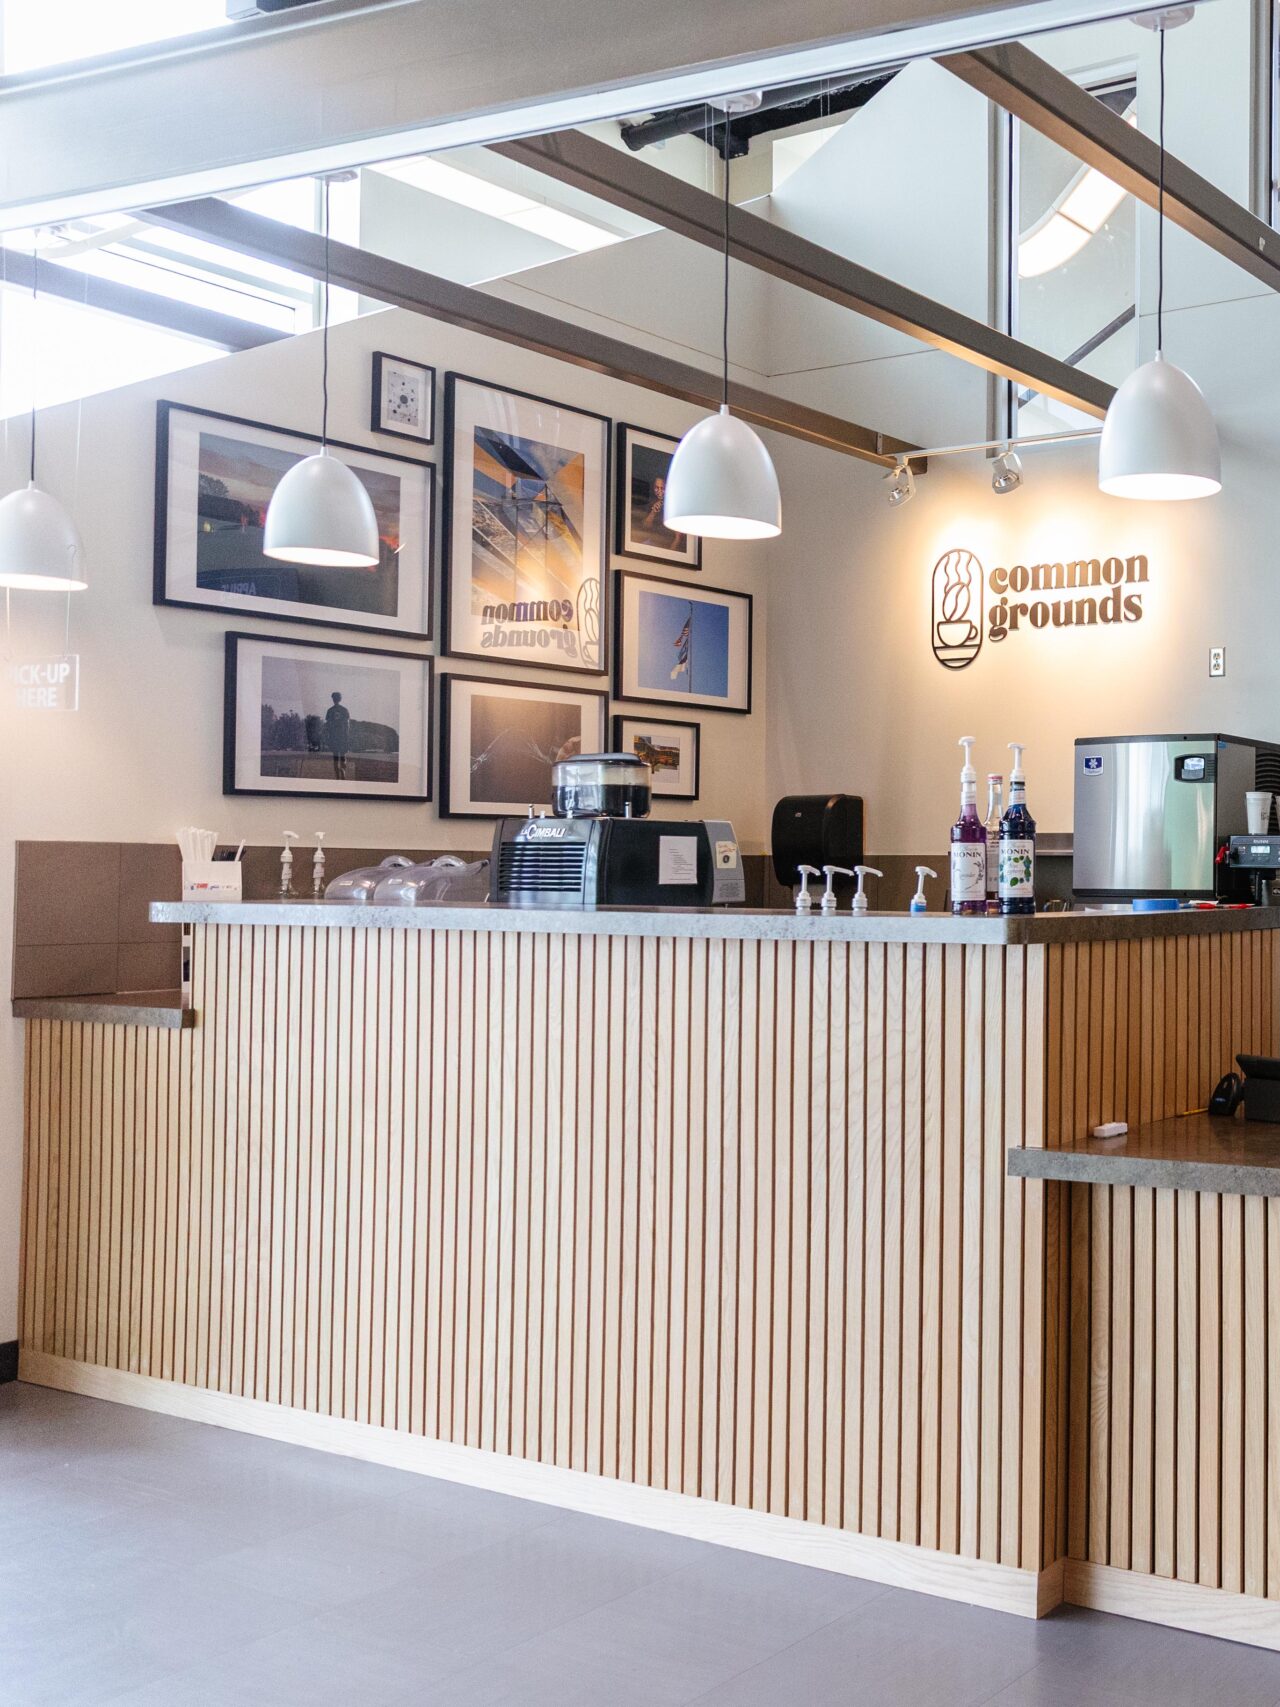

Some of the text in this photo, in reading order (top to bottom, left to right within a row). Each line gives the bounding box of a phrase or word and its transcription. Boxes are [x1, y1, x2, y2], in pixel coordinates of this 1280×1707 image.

[988, 555, 1150, 594] common
[988, 585, 1143, 642] grounds
[14, 663, 71, 685] ICK-UP
[15, 687, 58, 708] HERE
